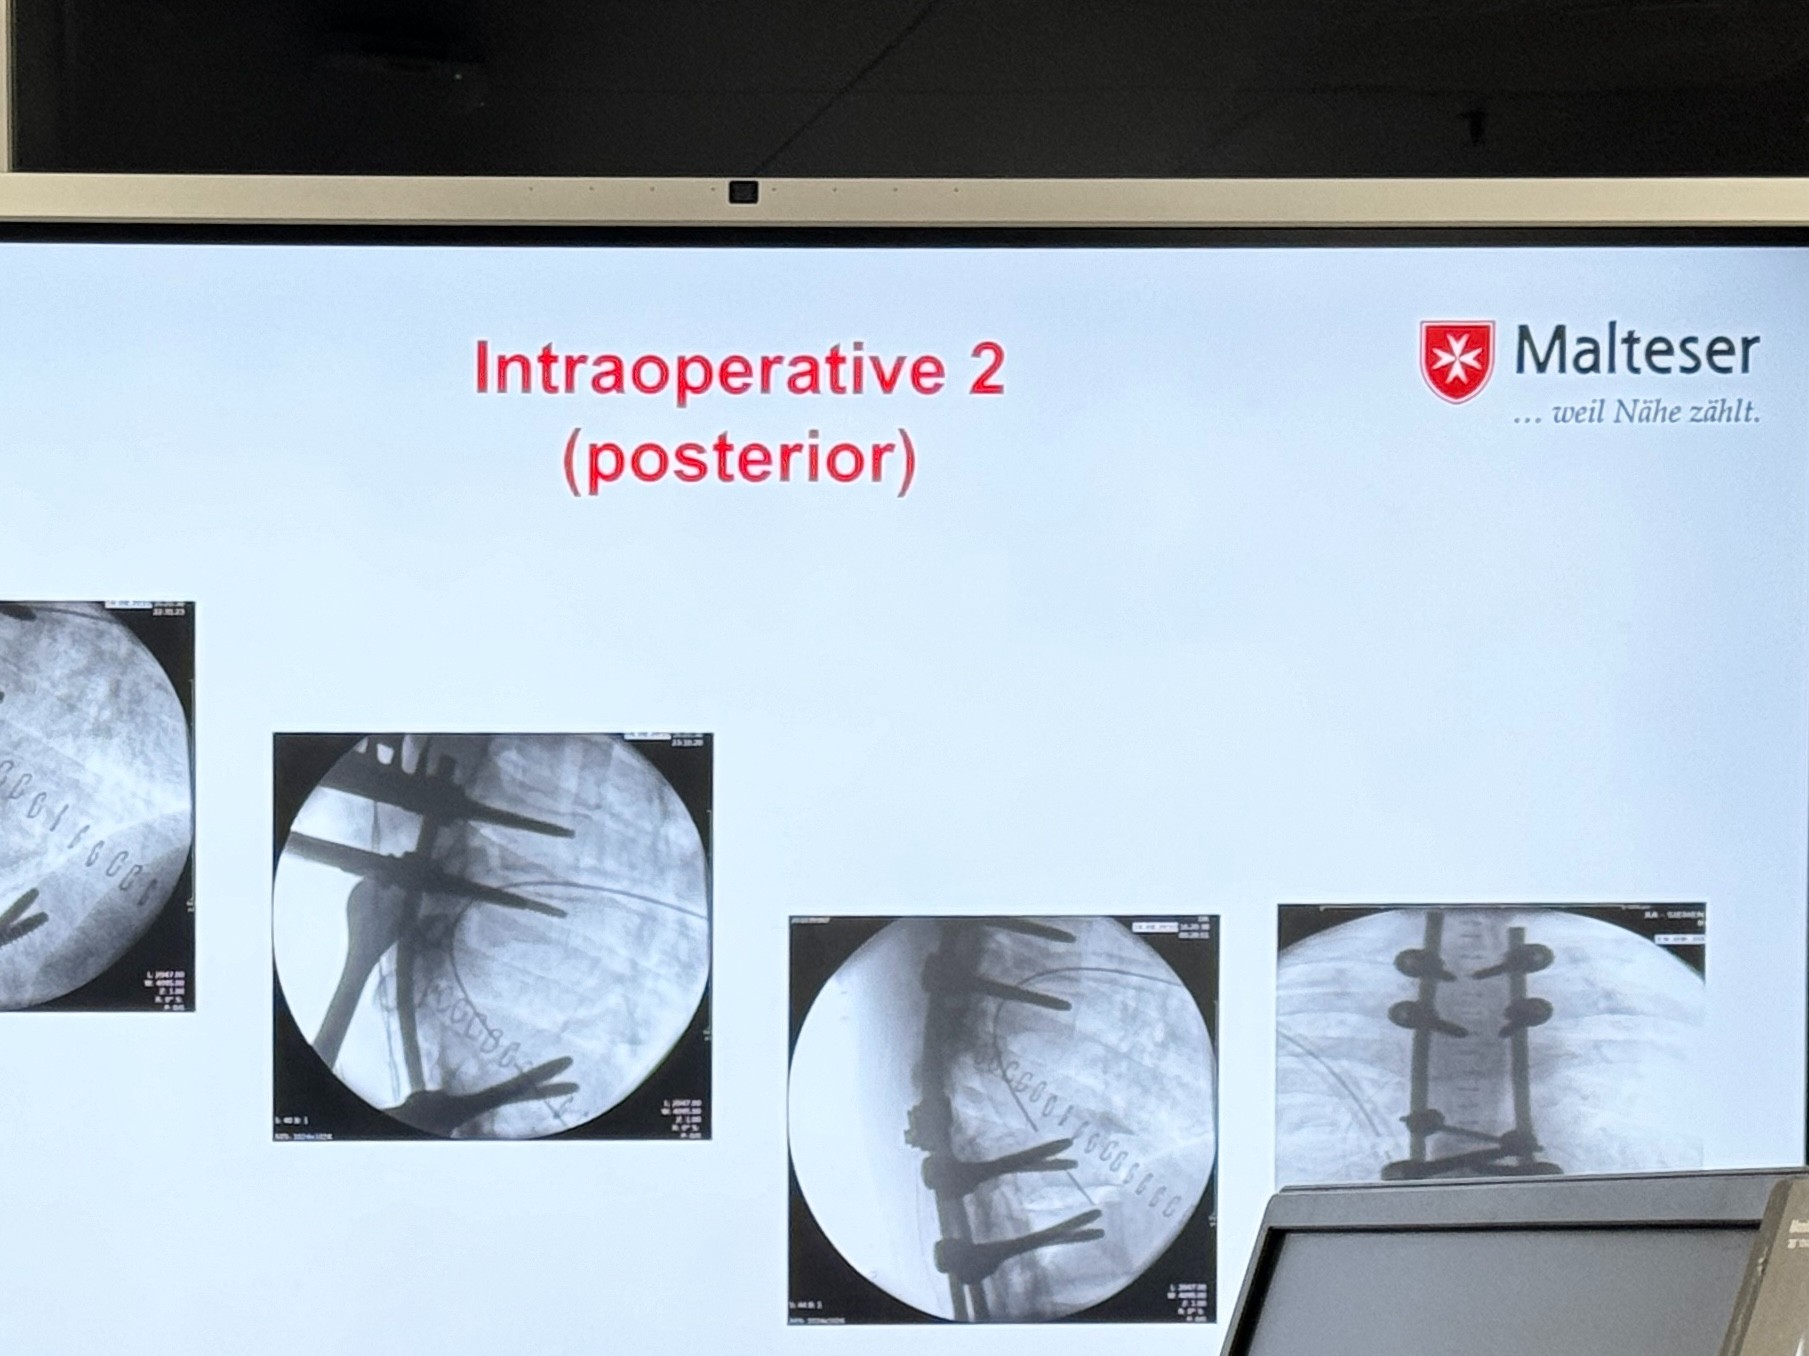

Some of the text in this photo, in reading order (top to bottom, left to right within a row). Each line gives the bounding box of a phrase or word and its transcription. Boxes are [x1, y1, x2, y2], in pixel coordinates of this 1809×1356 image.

[475, 340, 1006, 408] Intraoperative 2
[1514, 320, 1762, 375] Malteser
[1551, 398, 1606, 425] weil
[1613, 398, 1682, 425] Nähe
[1689, 398, 1761, 425] zählt.
[563, 426, 916, 498] (posterior)
